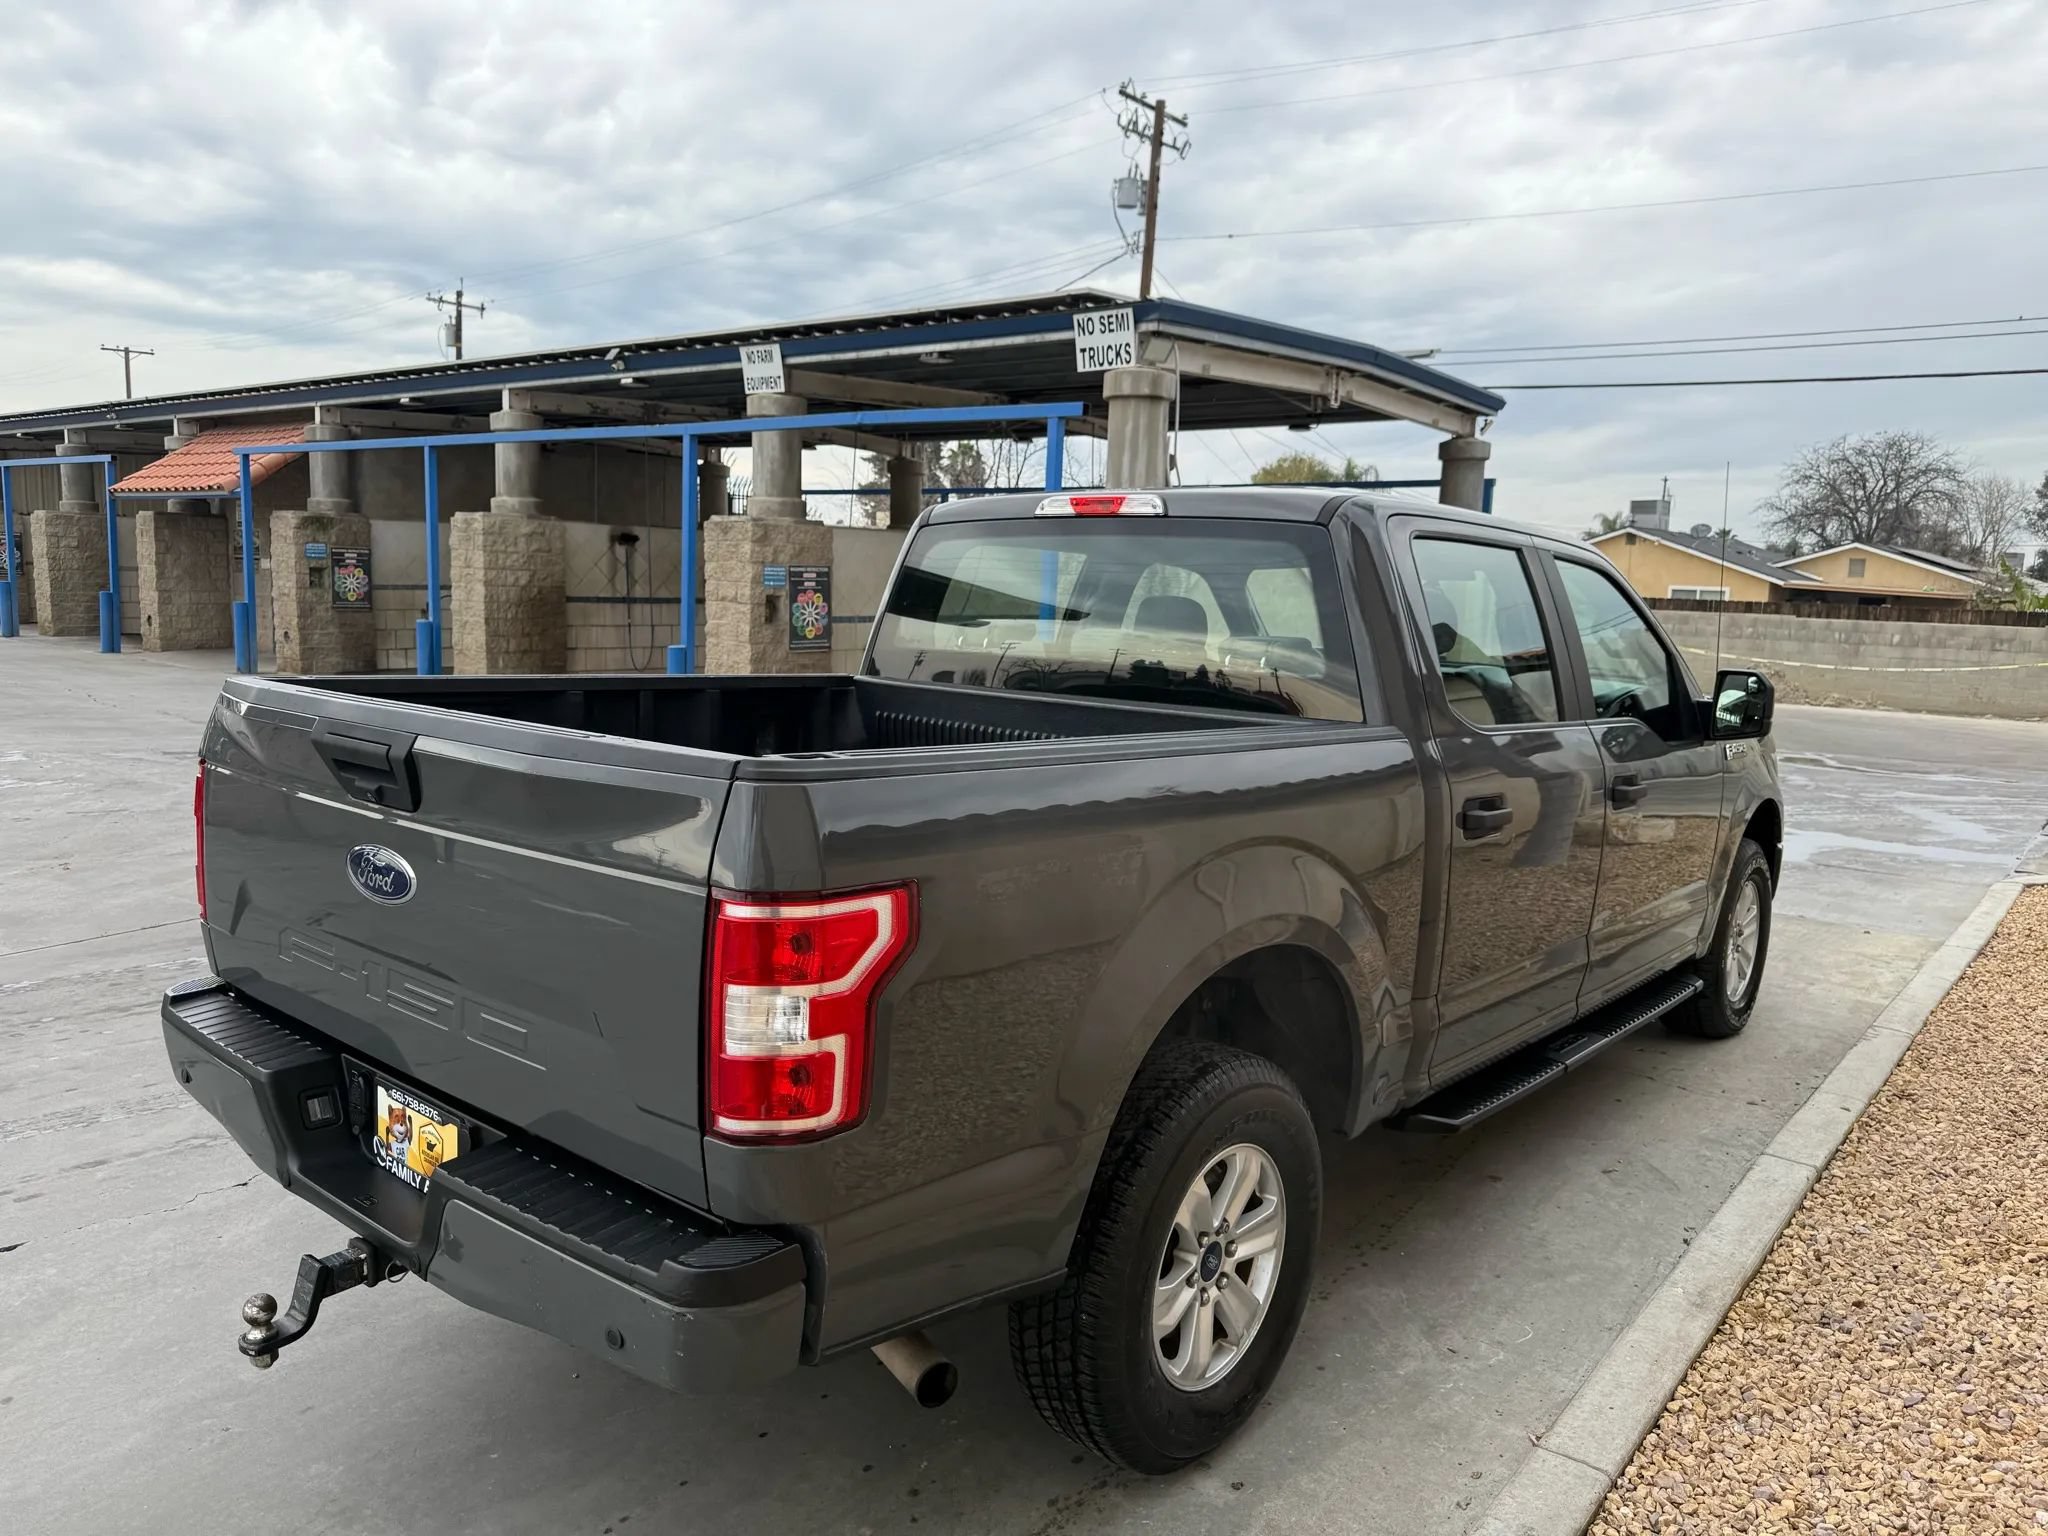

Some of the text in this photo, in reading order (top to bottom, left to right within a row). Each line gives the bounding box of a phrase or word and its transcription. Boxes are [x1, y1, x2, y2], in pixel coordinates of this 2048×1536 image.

[1077, 312, 1130, 337] NO SEMI
[745, 348, 774, 365] NO FARM
[1080, 342, 1132, 369] TRUCKS
[746, 375, 782, 391] EQUIPMENT
[357, 852, 395, 893] Ford
[279, 925, 551, 1072] F-150
[391, 1089, 440, 1121] 661-758-8376
[386, 1156, 421, 1189] FAMILY
